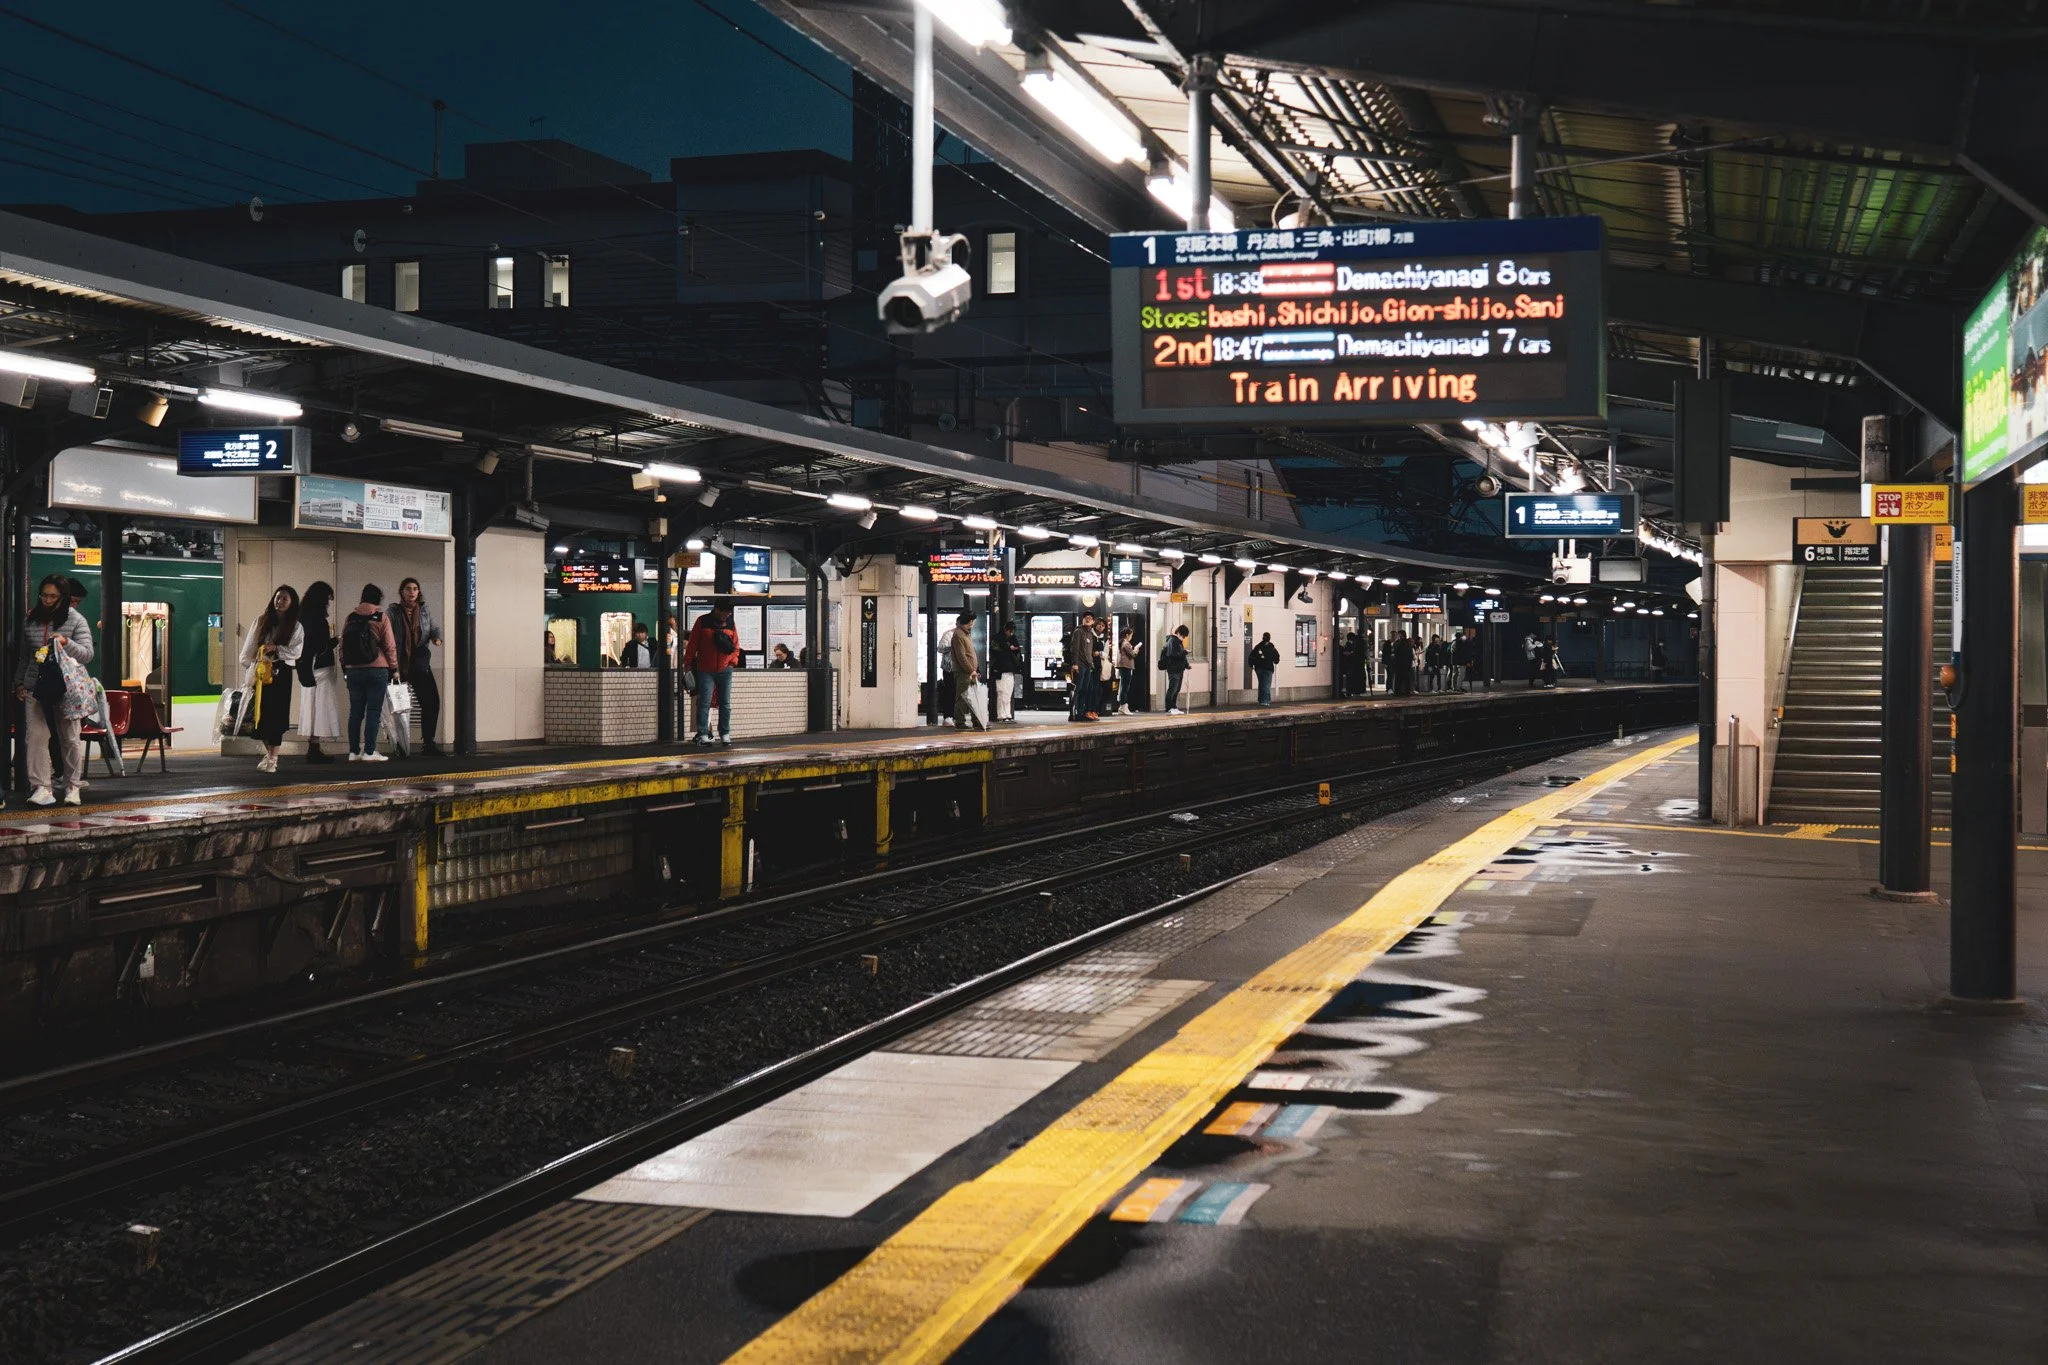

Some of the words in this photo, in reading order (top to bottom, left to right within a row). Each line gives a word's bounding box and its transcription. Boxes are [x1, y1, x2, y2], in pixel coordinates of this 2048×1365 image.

[1142, 236, 1156, 265] 1
[1155, 267, 1211, 301] 1st
[1212, 271, 1263, 296] 18:39
[1336, 263, 1489, 291] Demachiyanagi
[1141, 306, 1207, 329] Stops:
[1154, 333, 1213, 367] 2nd
[1213, 335, 1263, 361] 18:47
[1337, 329, 1489, 358] Demachiyanagi
[1497, 328, 1517, 354] 7
[1229, 371, 1319, 404] Train
[1333, 367, 1477, 403] Arriving
[265, 440, 277, 459] 2
[1877, 493, 1901, 502] STOP
[1904, 491, 1945, 501] 非常通報
[1905, 501, 1933, 510] ボタン
[1515, 506, 1526, 524] 1
[1804, 546, 1815, 562] 6
[1817, 546, 1833, 555] 号車
[1844, 546, 1869, 555] 指定席
[1037, 575, 1076, 584] COFFEE
[1320, 789, 1329, 798] 30
